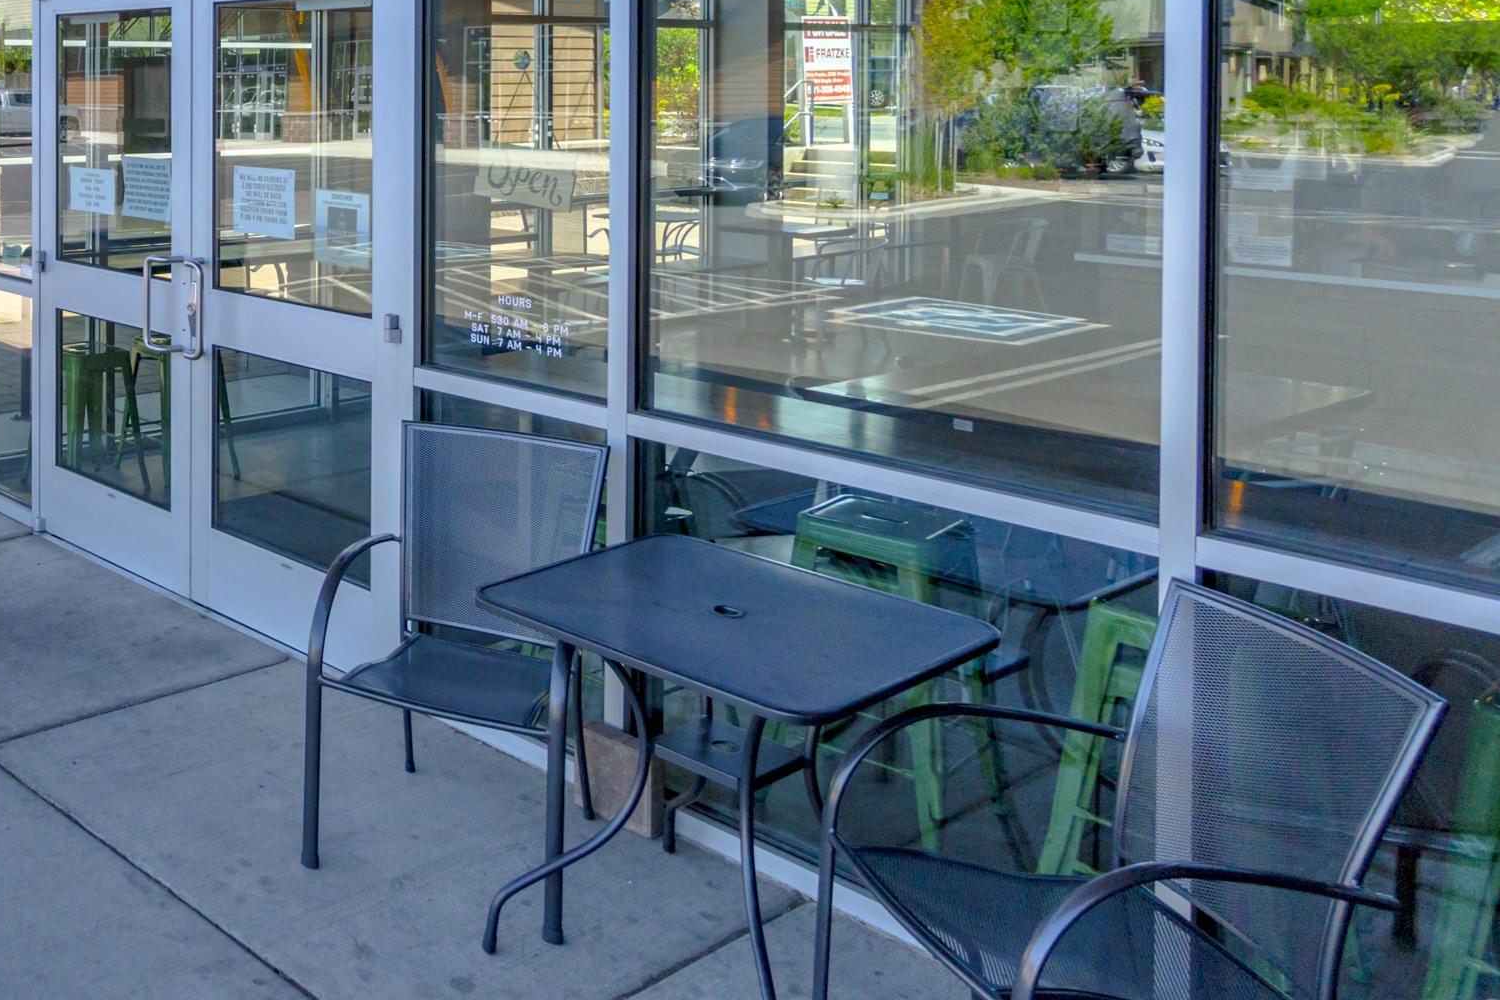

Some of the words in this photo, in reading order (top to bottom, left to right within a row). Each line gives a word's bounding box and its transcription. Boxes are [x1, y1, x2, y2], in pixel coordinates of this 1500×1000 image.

[816, 47, 850, 59] FRATZKE
[488, 165, 562, 206] Open
[498, 296, 532, 308] HOURS
[464, 311, 483, 320] M-F
[491, 315, 509, 326] 530
[513, 319, 529, 329] AM
[554, 325, 569, 336] PM
[471, 323, 490, 334] SAT
[497, 327, 503, 335] 7
[506, 329, 521, 339] AM
[536, 333, 542, 343] 4
[546, 335, 561, 347] PM
[470, 334, 490, 345] SUN
[498, 338, 503, 347] 7
[507, 340, 522, 351] AM
[536, 345, 542, 354] 4
[547, 347, 562, 358] PM
